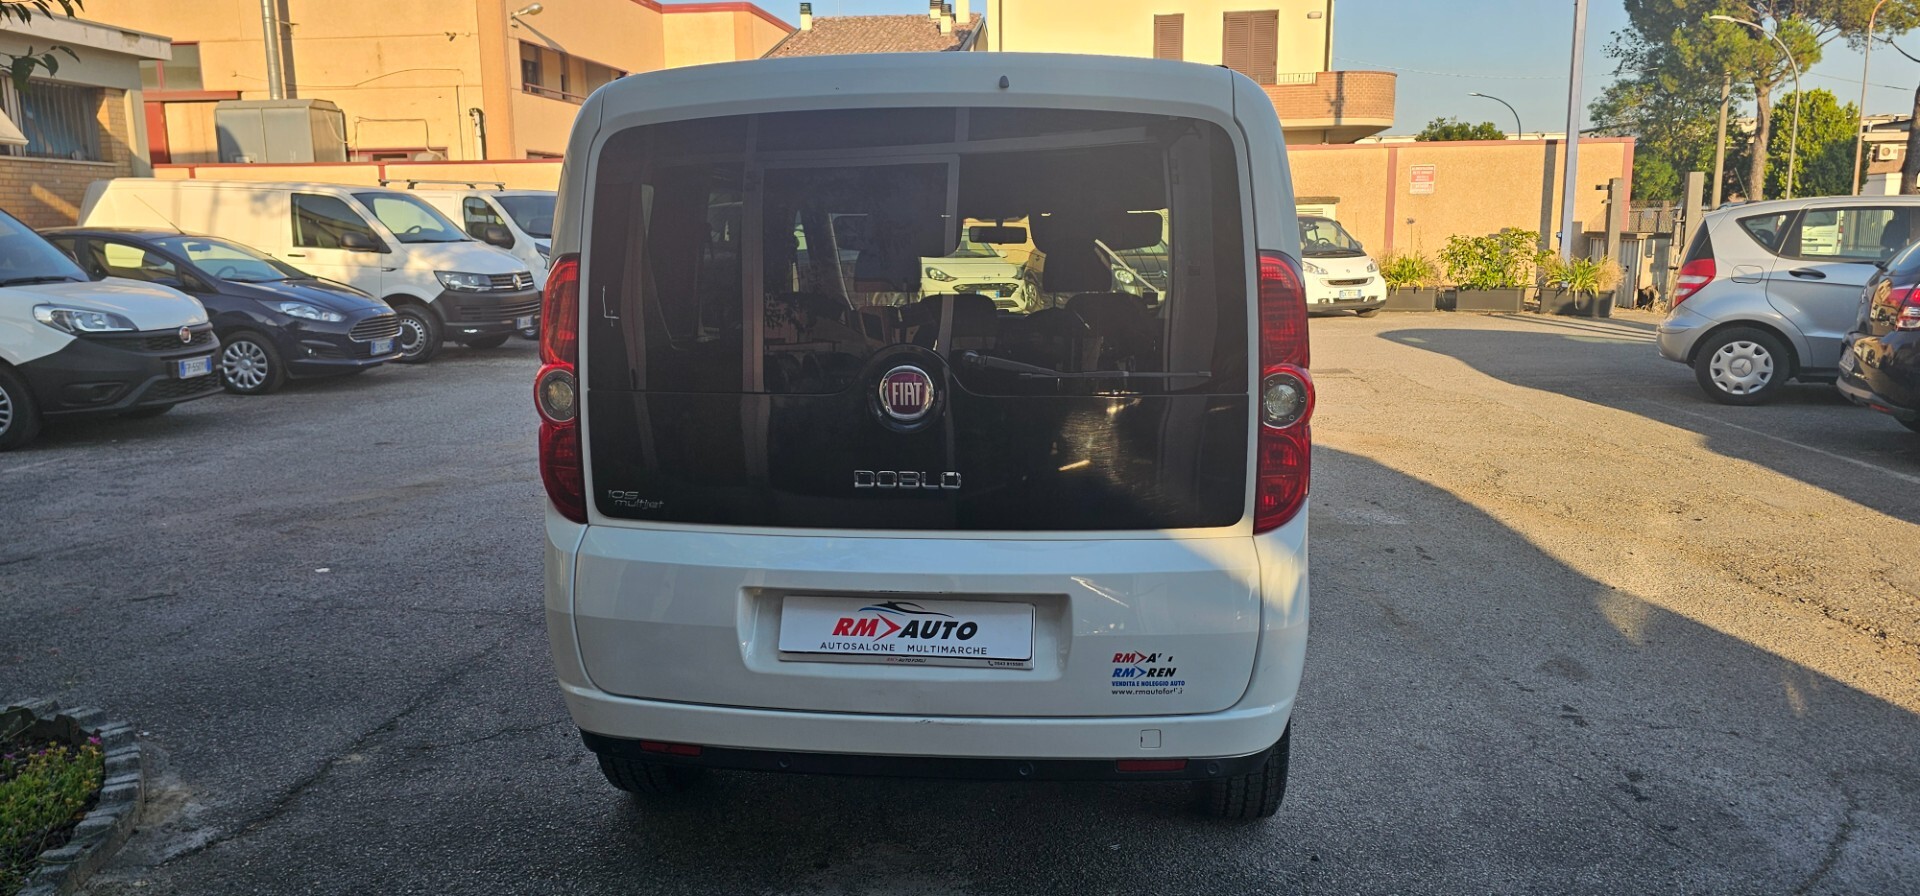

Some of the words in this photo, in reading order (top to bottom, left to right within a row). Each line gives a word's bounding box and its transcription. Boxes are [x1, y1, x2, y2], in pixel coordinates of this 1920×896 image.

[892, 382, 922, 406] FIAT
[854, 470, 961, 488] DOBLO
[832, 617, 880, 637] RM
[898, 619, 979, 641] AUTO
[820, 640, 896, 652] AUTOSALONE
[906, 643, 988, 656] MULTIMARCHE
[1112, 652, 1137, 664] RM
[1112, 667, 1136, 678] RM
